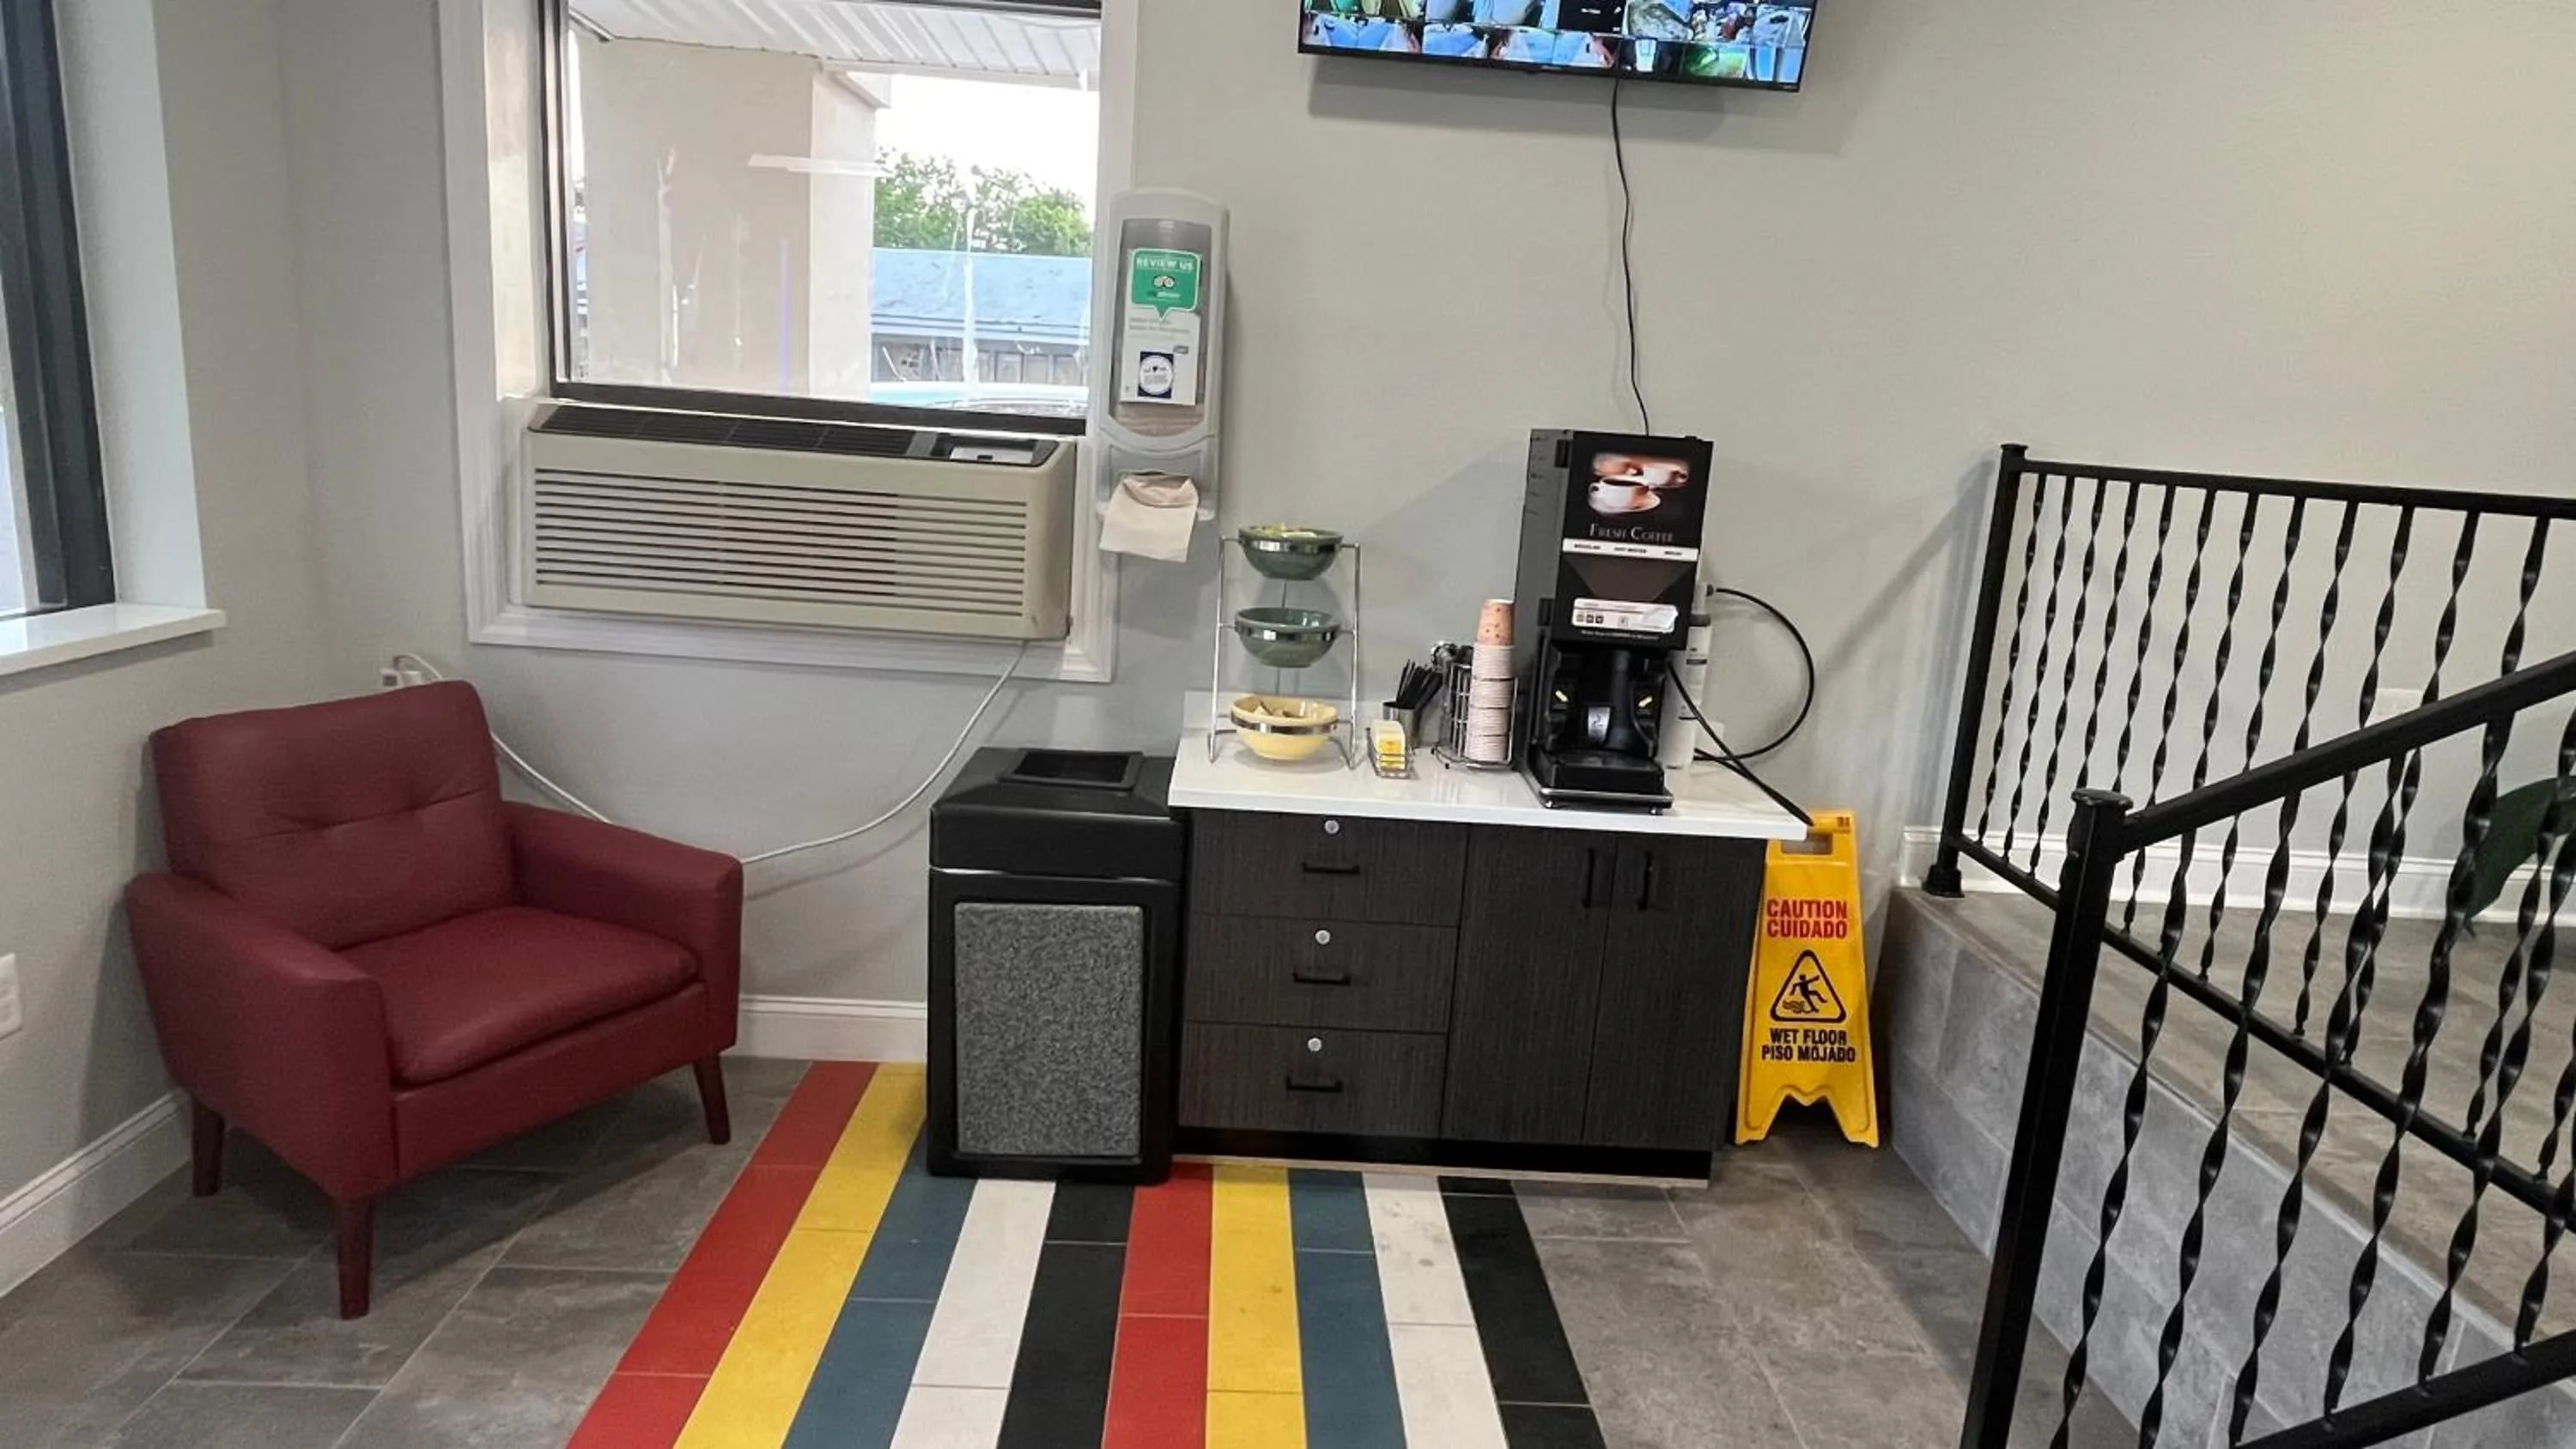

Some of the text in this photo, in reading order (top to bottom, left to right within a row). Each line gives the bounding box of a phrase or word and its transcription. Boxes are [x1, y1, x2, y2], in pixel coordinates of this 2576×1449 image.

[1137, 258, 1193, 271] REVIEW US
[1766, 899, 1847, 919] CAUTION
[1766, 919, 1847, 938] CUIDADO
[1770, 1028, 1847, 1046] WET FLOOR
[1761, 1045, 1856, 1062] PISO MOJADO
